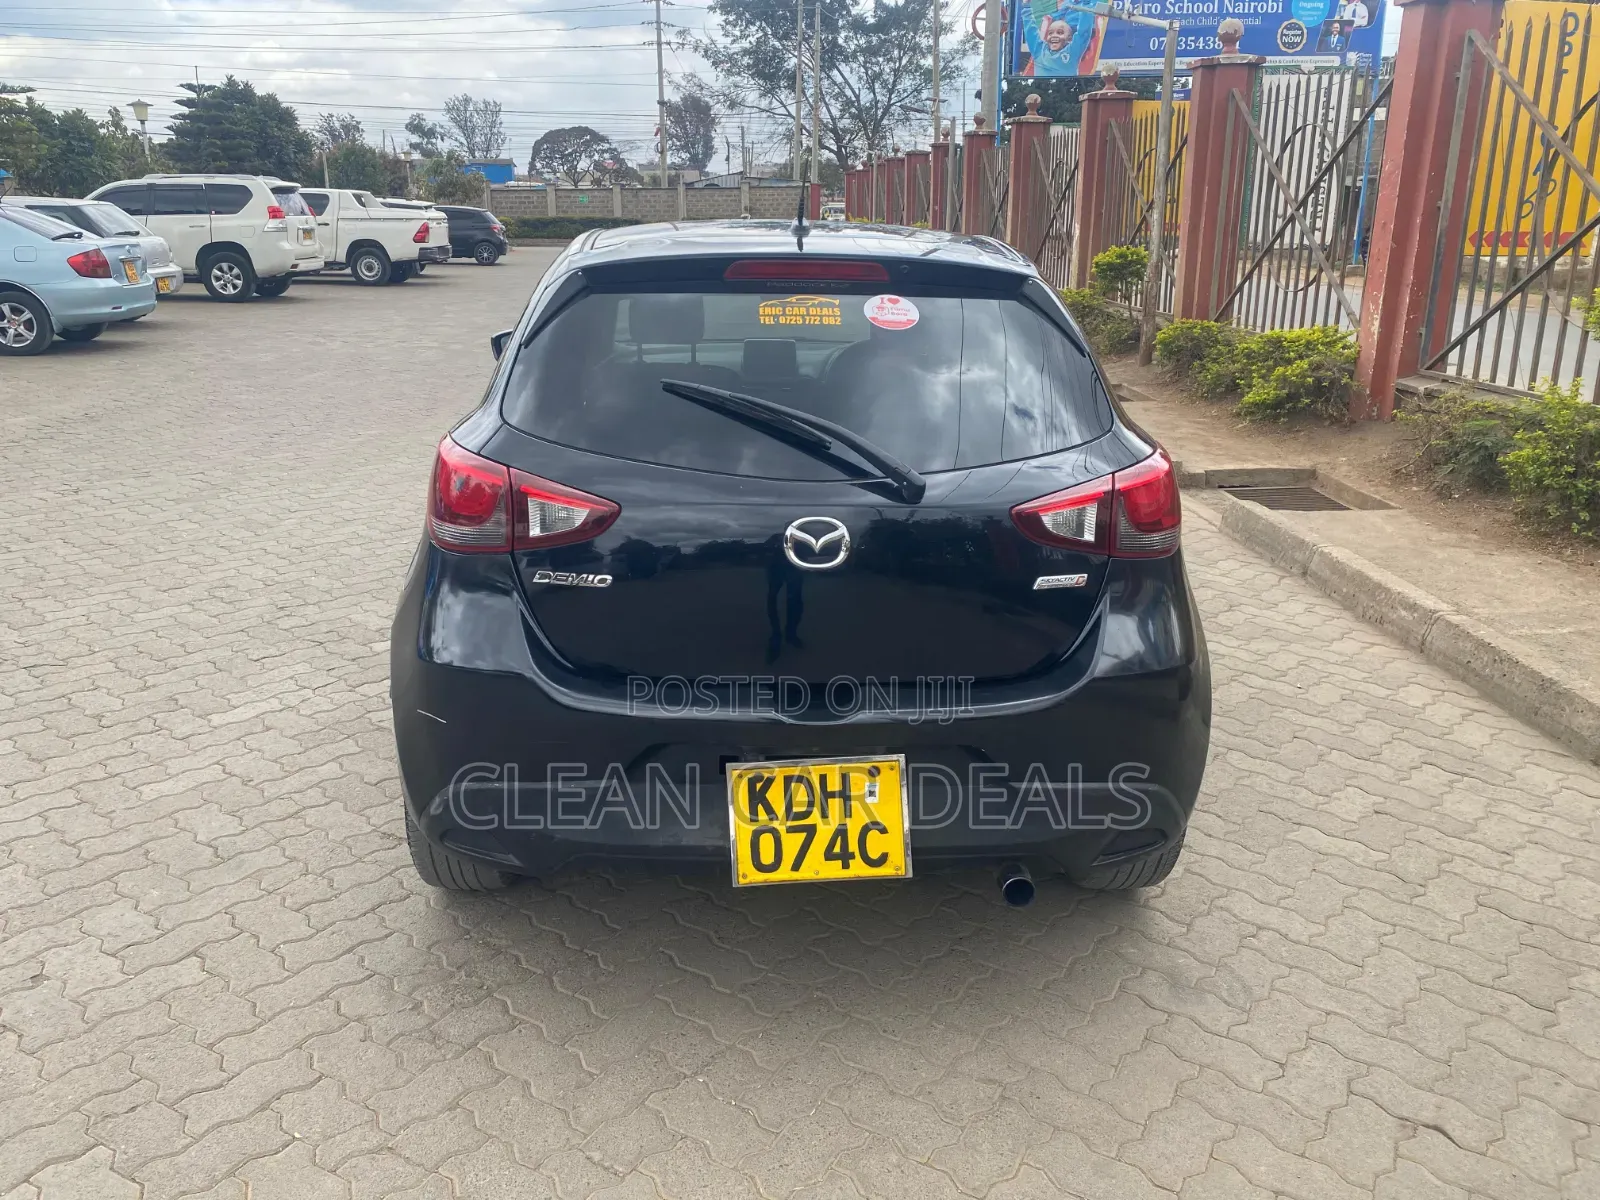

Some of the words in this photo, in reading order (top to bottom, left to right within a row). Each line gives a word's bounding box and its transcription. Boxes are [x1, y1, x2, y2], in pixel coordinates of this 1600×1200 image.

[1165, 0, 1218, 14] School
[1223, 0, 1283, 14] Nairobi
[1176, 17, 1194, 26] ach
[1149, 36, 1241, 51] 07354381
[759, 306, 783, 316] ERIC
[785, 306, 807, 316] CAR
[809, 307, 840, 316] DEALS
[779, 316, 803, 325] 0725
[805, 316, 820, 325] 772
[532, 570, 613, 588] DEMIO
[748, 772, 852, 823] KDH
[750, 821, 889, 873] 074C
